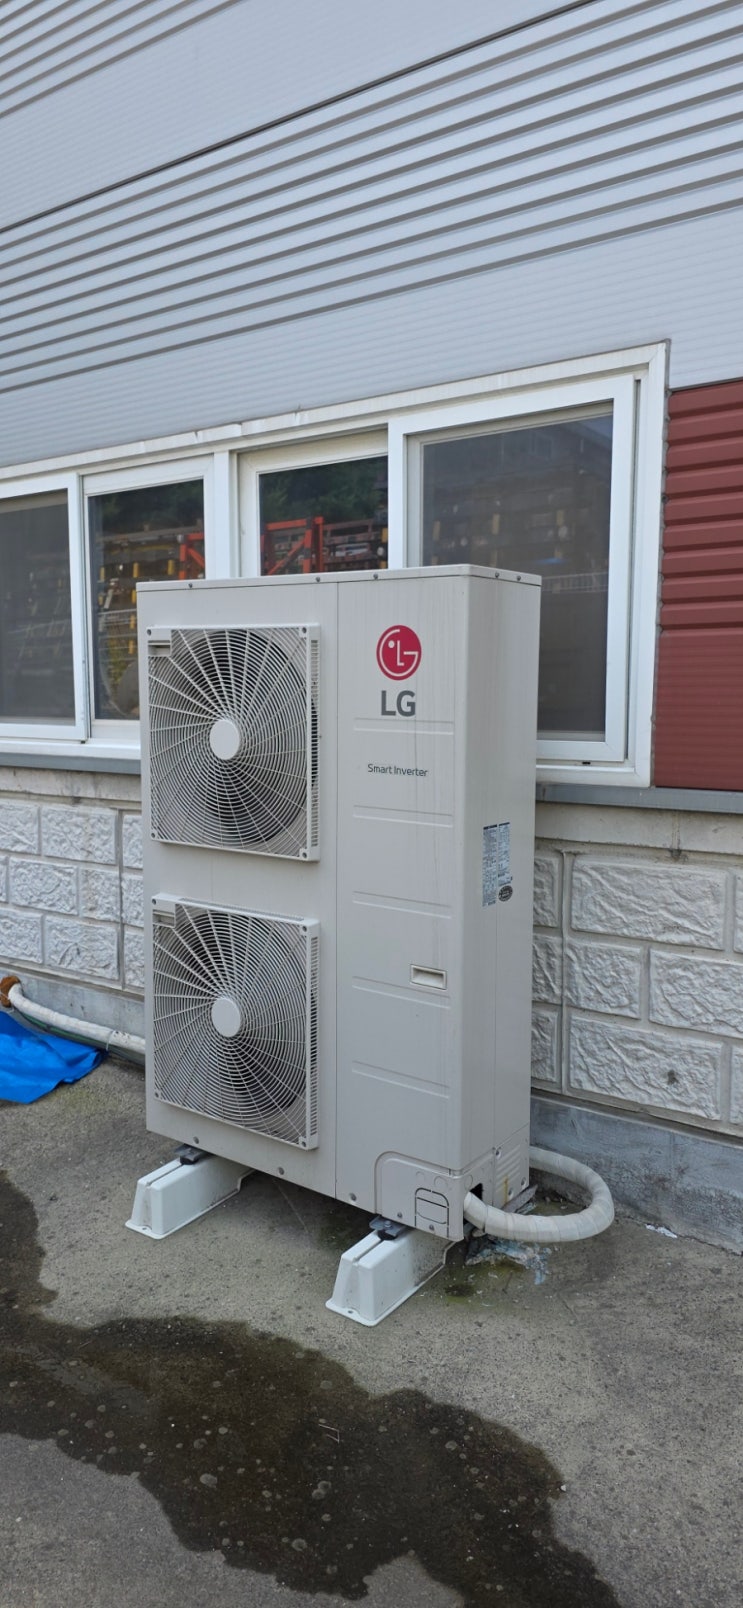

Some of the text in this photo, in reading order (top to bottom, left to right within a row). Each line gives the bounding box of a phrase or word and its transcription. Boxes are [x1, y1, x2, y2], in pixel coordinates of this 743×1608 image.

[381, 690, 416, 717] LG
[367, 763, 428, 777] Smart Inverter
